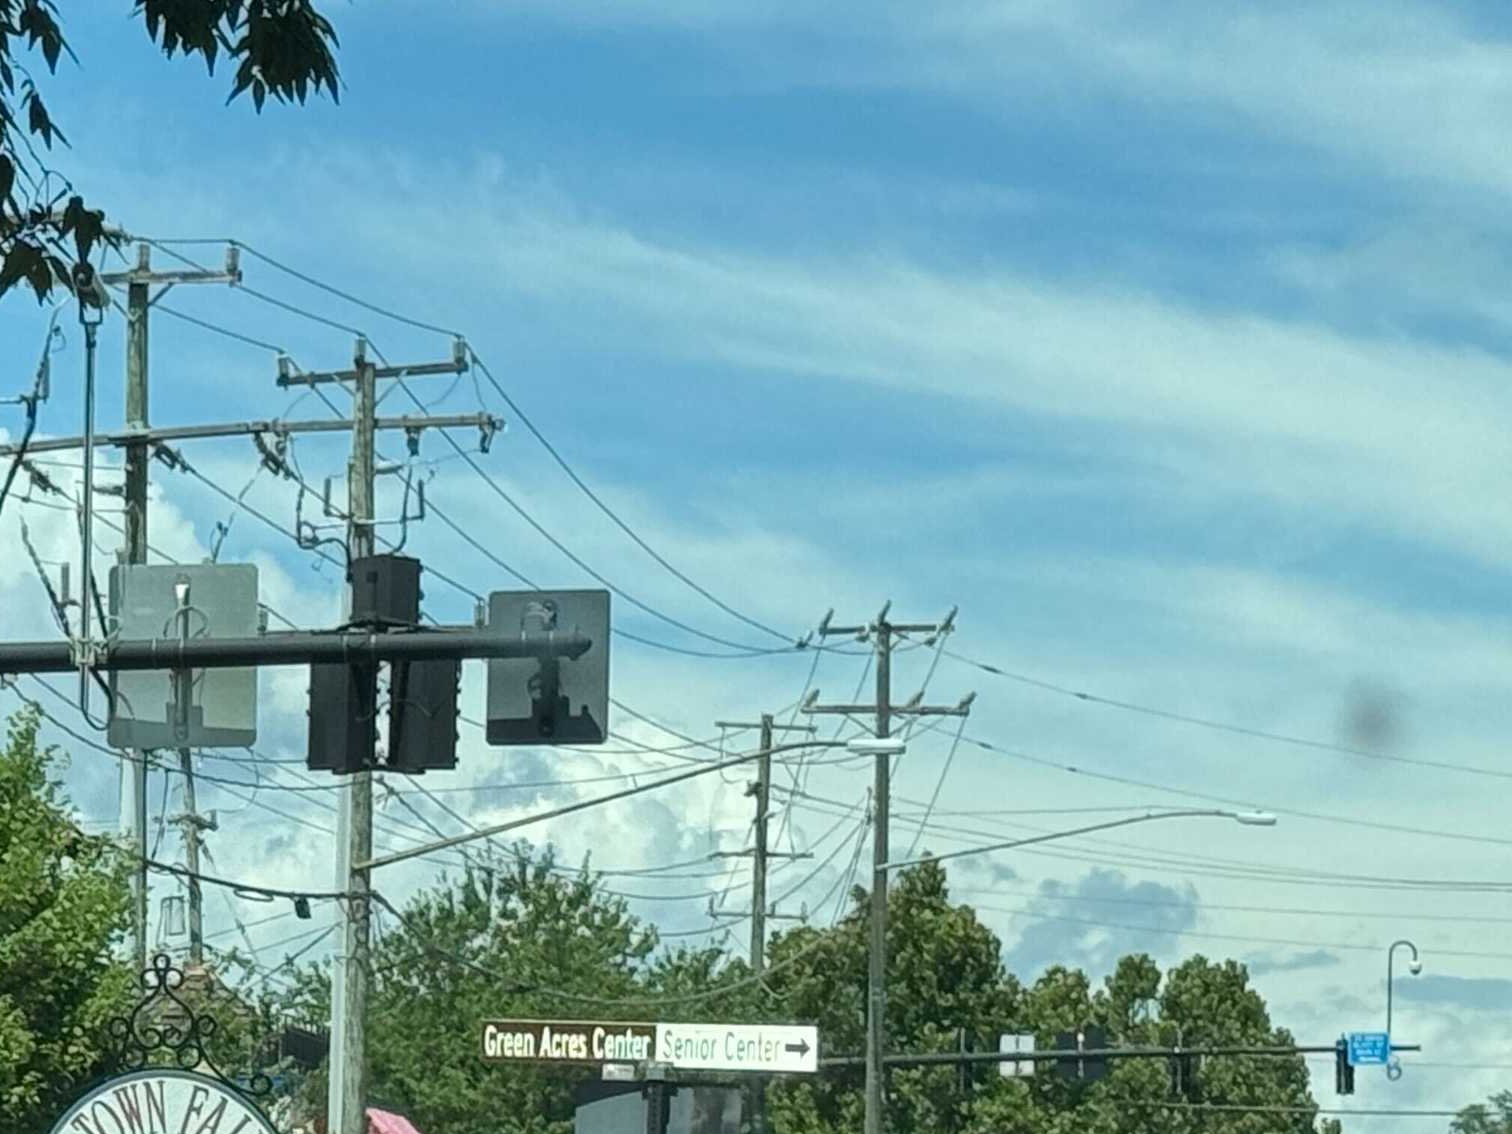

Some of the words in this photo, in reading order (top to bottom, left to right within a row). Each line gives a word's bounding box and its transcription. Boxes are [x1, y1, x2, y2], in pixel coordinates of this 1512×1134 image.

[484, 1024, 536, 1057] Green
[539, 1026, 587, 1058] Acres
[592, 1026, 651, 1060] Center
[663, 1029, 717, 1060] Senior
[725, 1031, 781, 1062] Center
